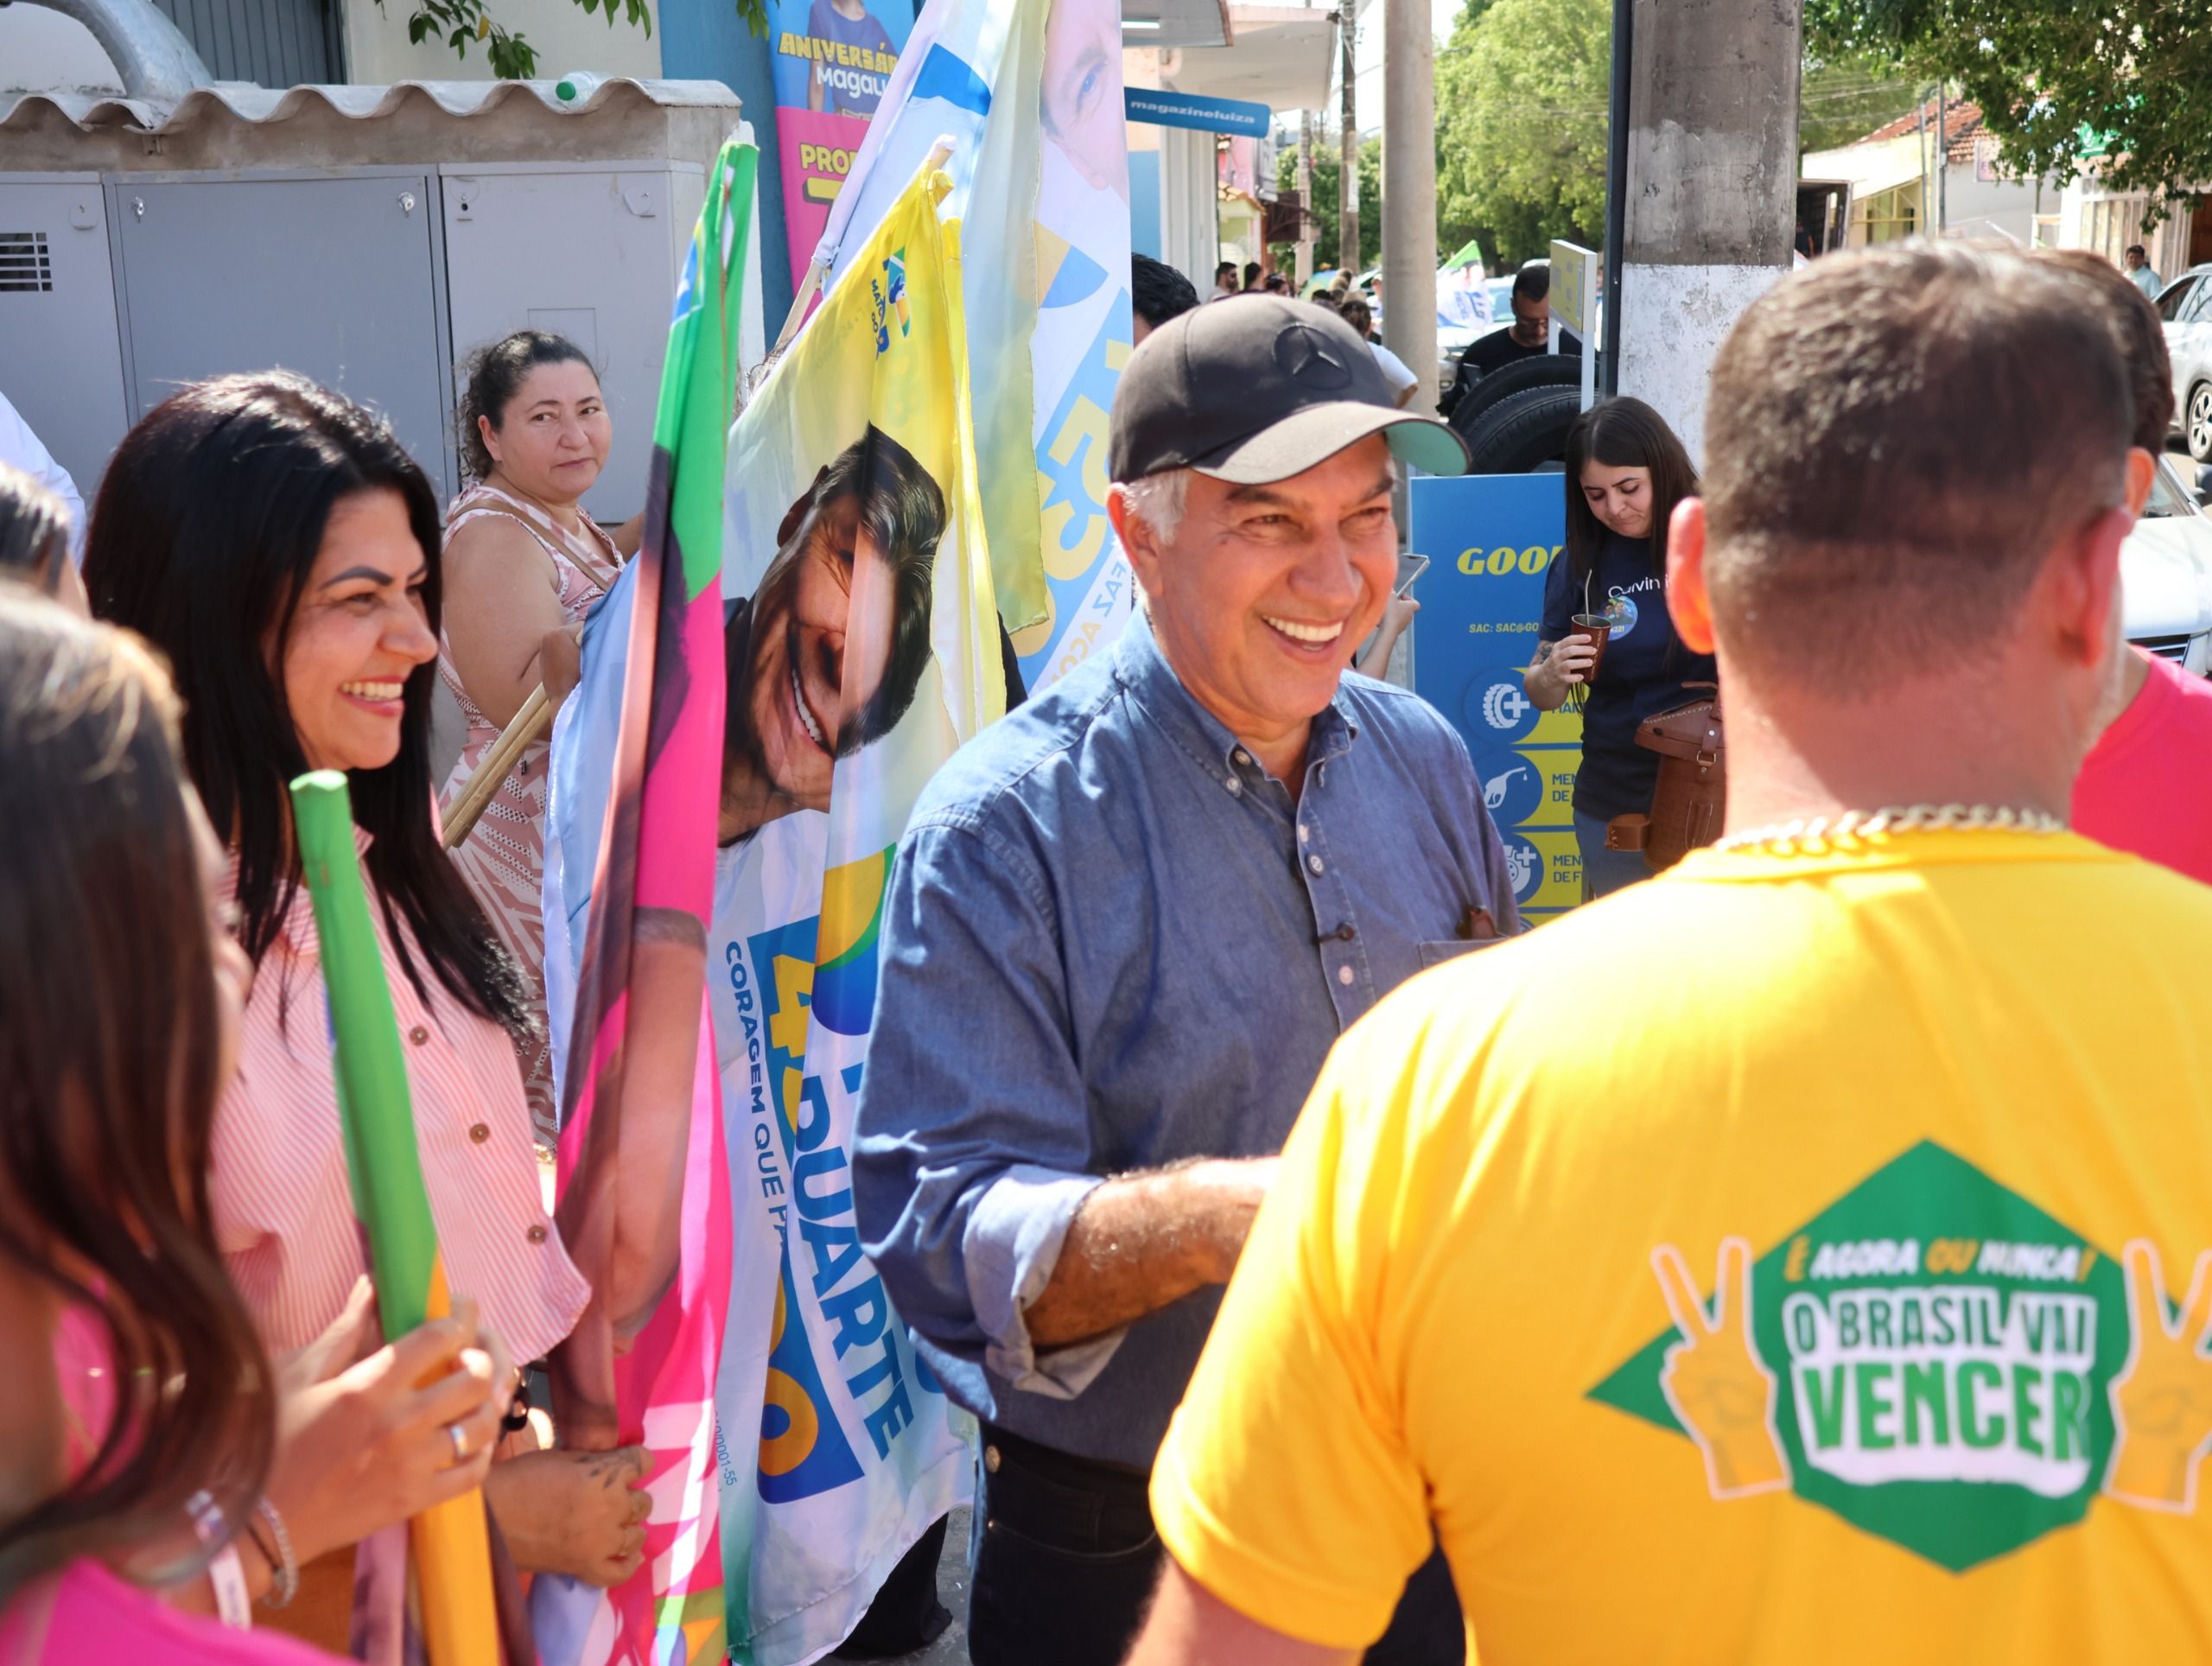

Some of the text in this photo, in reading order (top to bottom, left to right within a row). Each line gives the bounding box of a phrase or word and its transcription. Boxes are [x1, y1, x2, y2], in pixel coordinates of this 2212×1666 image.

[1131, 101, 1255, 124] magazineluiza
[1469, 623, 1493, 633] SAC:
[1552, 791, 1570, 802] DE
[1554, 871, 1571, 883] DE
[726, 940, 766, 1115] CORAGEM
[754, 1122, 785, 1199] QUE
[793, 1074, 914, 1461] DUARTE
[1926, 1238, 1979, 1274] OU
[1792, 1301, 1817, 1353] O
[1838, 1296, 2004, 1348] BRASIL
[1801, 1359, 2092, 1462] VENCER
